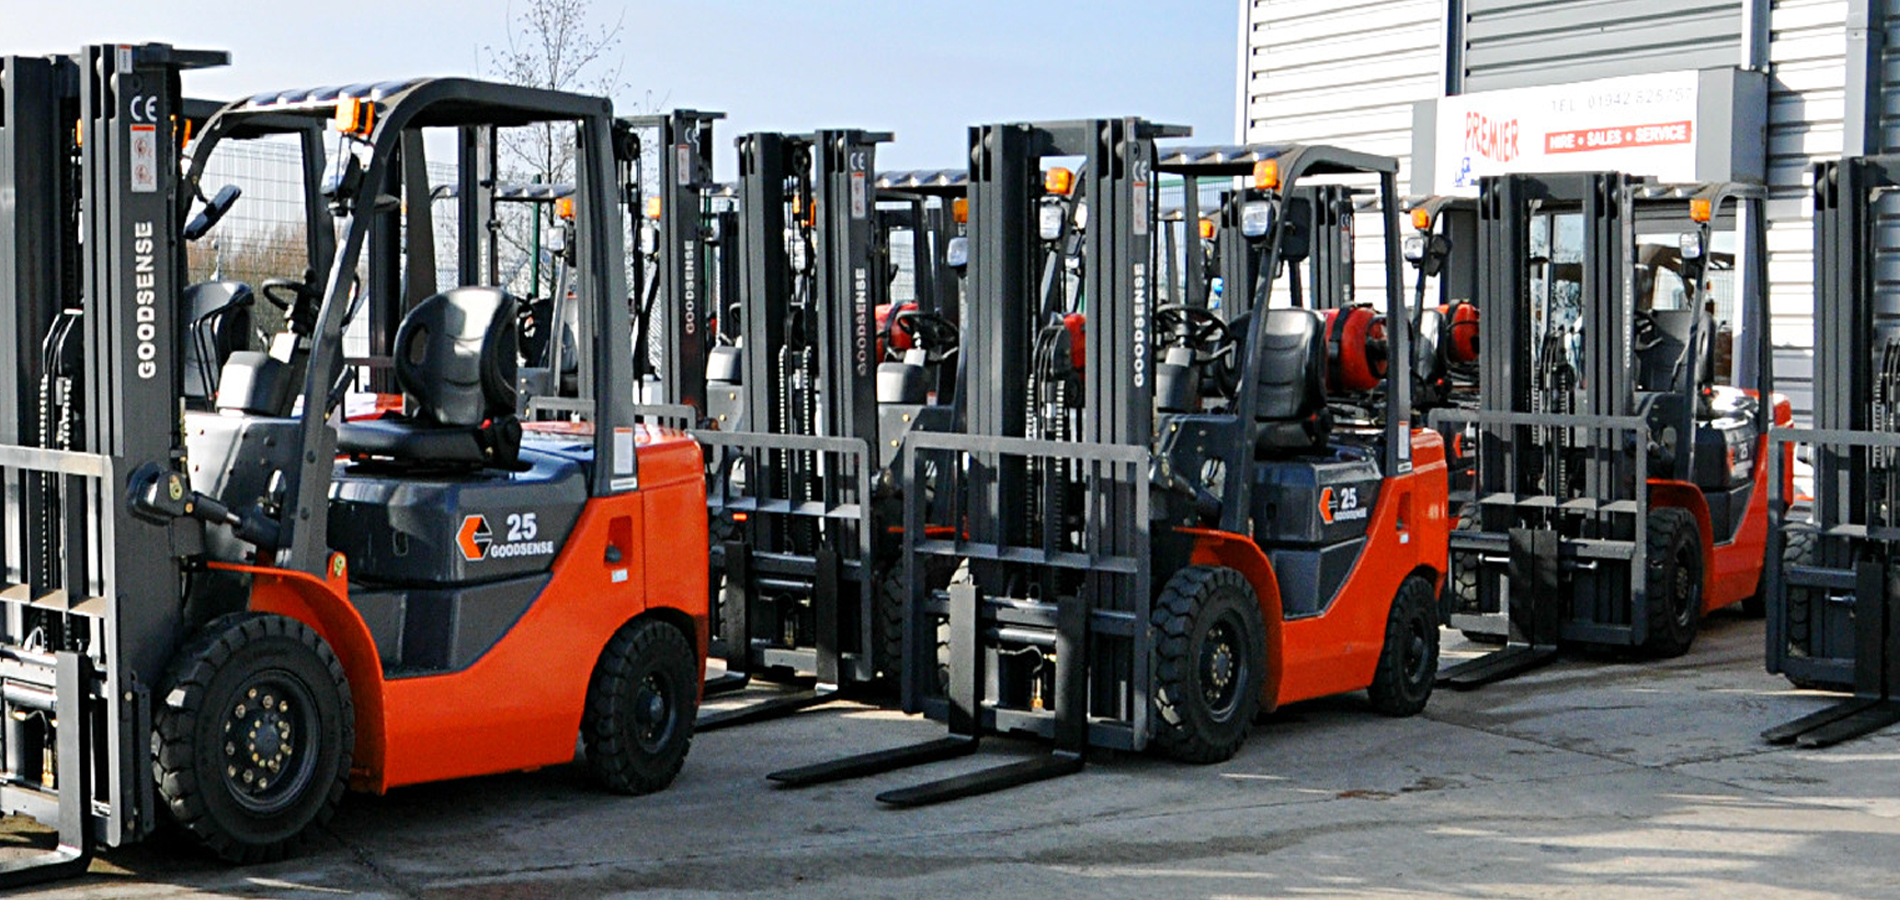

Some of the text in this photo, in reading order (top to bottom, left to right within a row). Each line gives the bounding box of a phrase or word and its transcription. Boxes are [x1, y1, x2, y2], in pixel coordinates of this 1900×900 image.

[130, 96, 157, 121] CE
[1552, 98, 1575, 112] TEL
[1464, 111, 1519, 162] PREMIER
[1549, 124, 1687, 149] HIRE SALES SERVICE
[850, 152, 865, 171] CE
[1133, 161, 1148, 181] CE
[684, 240, 695, 334] GOODSENSE
[135, 221, 156, 379] GOODSENSE
[855, 268, 867, 377] GOODSENSE
[1133, 263, 1146, 388] GOODSENSE
[1341, 487, 1358, 510] 25
[507, 513, 537, 542] 25
[490, 541, 554, 558] GOODSENSE
